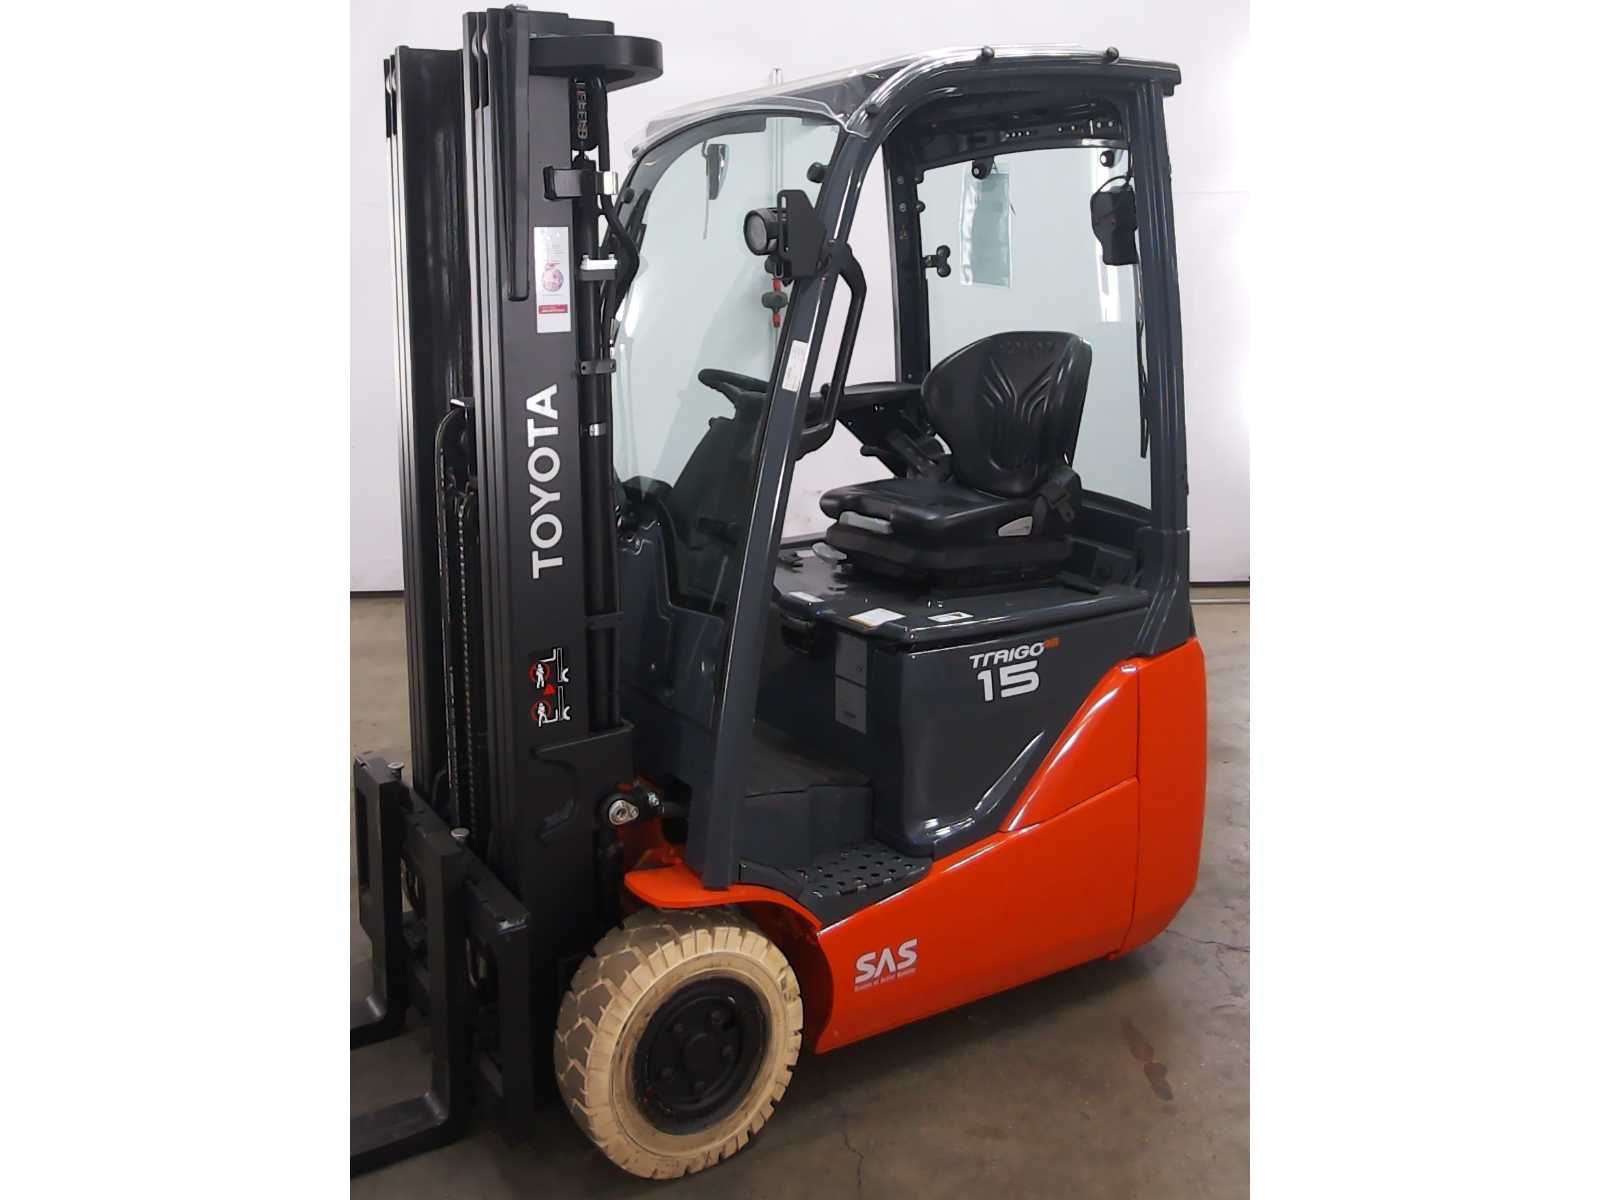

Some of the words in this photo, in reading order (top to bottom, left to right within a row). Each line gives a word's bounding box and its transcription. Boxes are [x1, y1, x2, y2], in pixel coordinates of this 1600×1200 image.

[526, 383, 564, 580] TOYOTA
[969, 642, 1045, 669] TRAIGO
[977, 660, 1040, 702] 15
[855, 938, 918, 985] SAS
